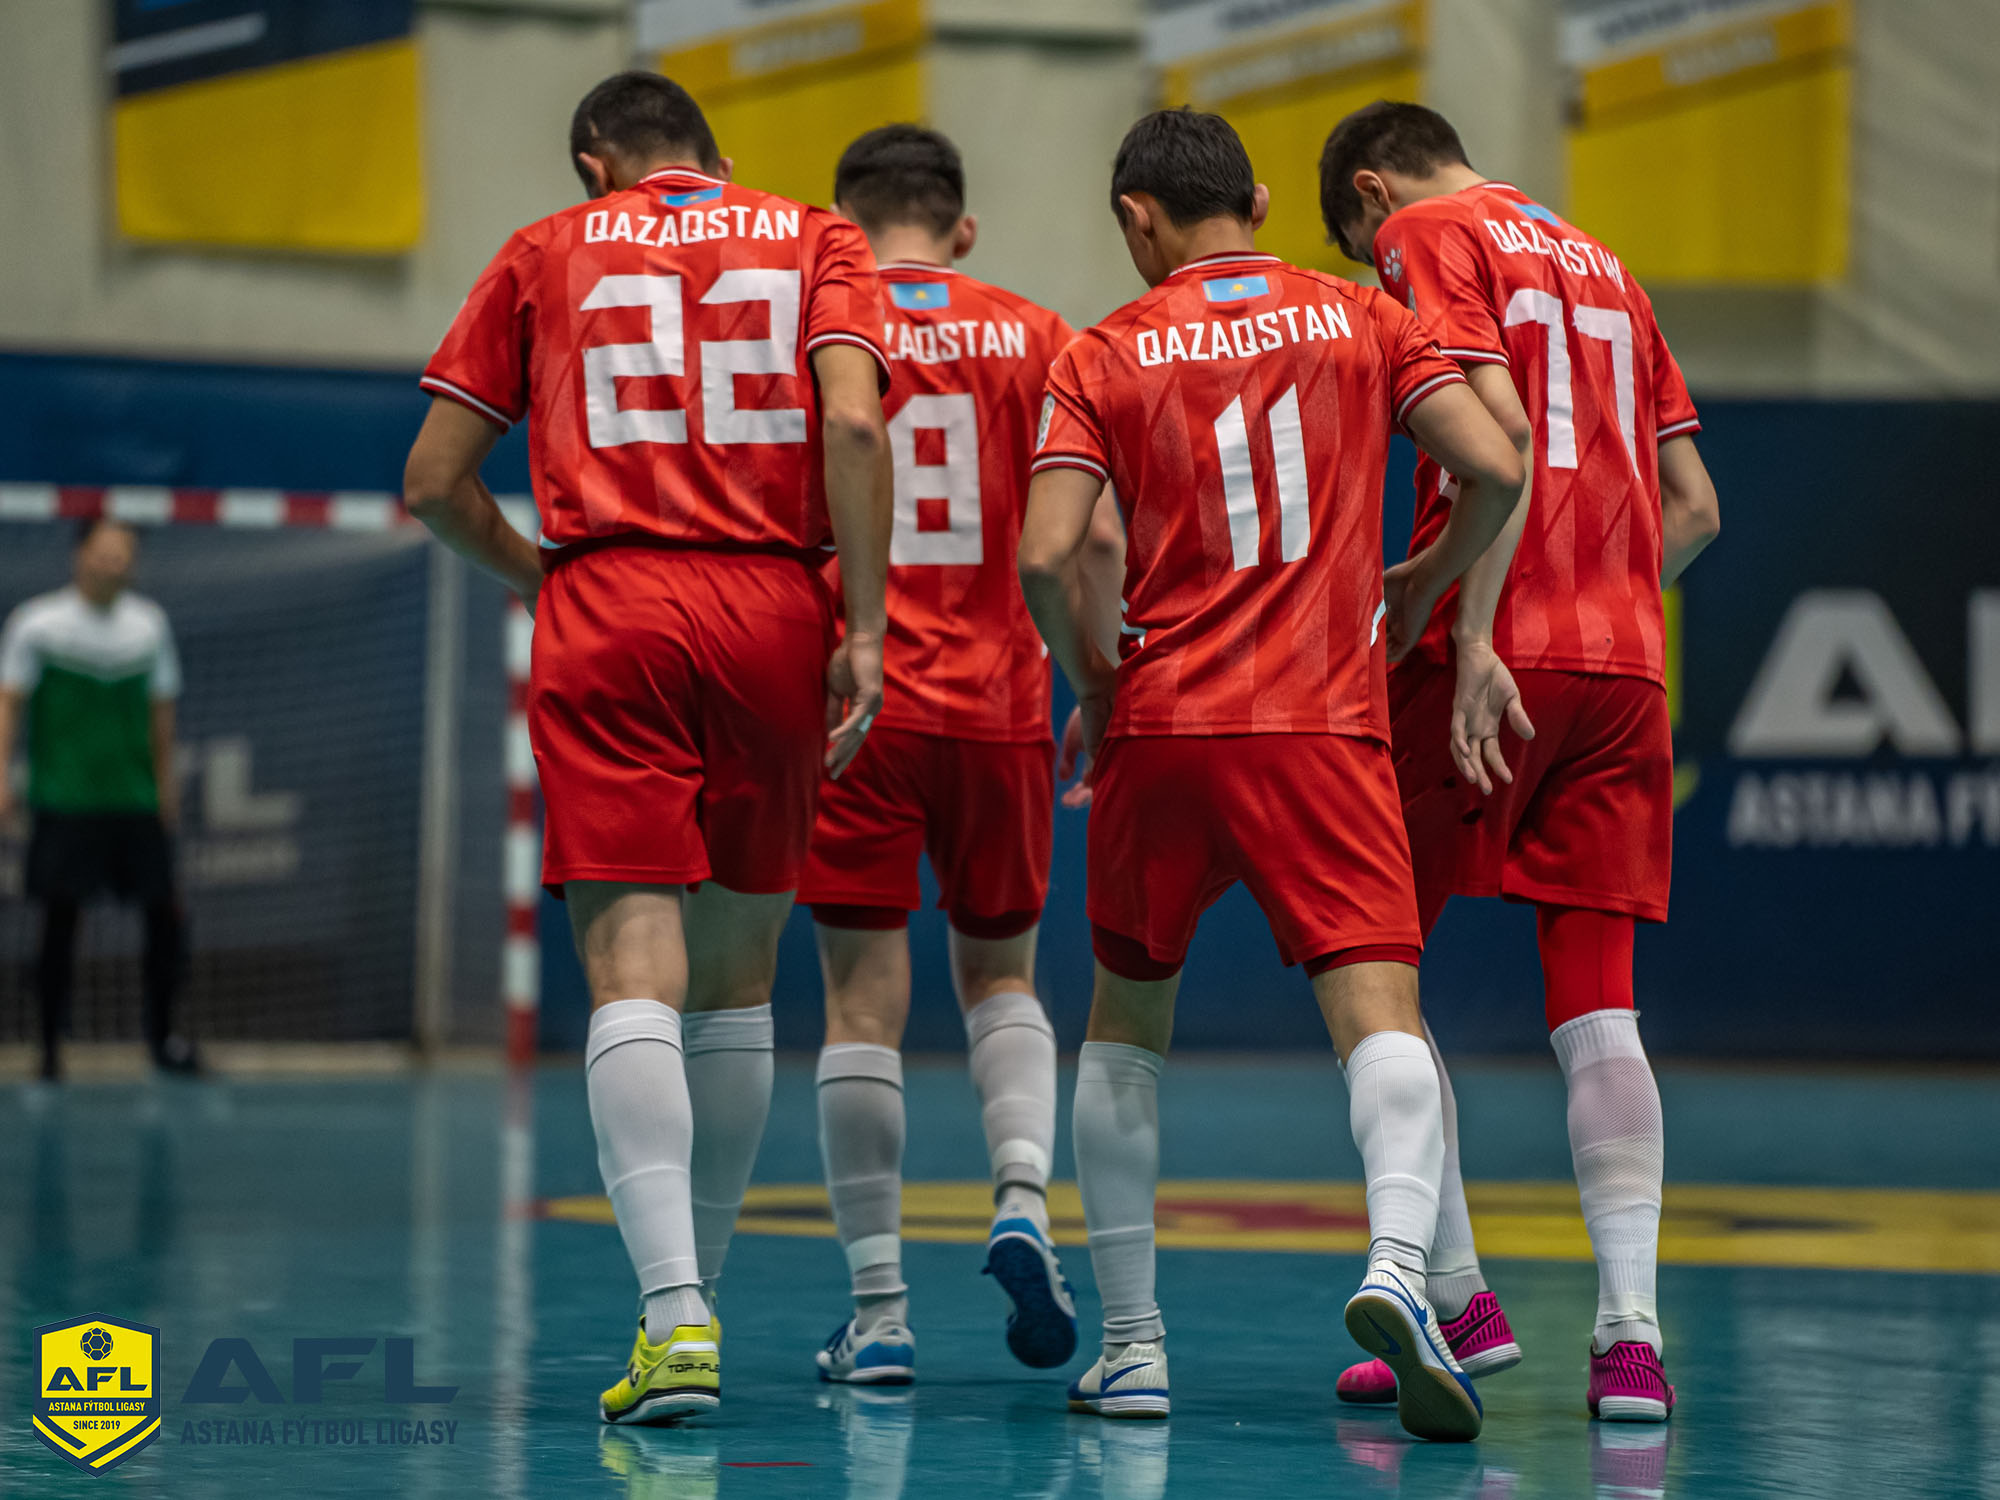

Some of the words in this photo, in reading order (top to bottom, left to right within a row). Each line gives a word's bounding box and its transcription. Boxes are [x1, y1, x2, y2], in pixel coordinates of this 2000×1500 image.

[584, 205, 799, 247] QAZAQSTAN
[579, 269, 807, 449] 22
[1136, 303, 1353, 367] QAZAQSTAN
[1504, 288, 1642, 486] 77
[886, 393, 984, 566] 8
[1214, 383, 1311, 571] 11
